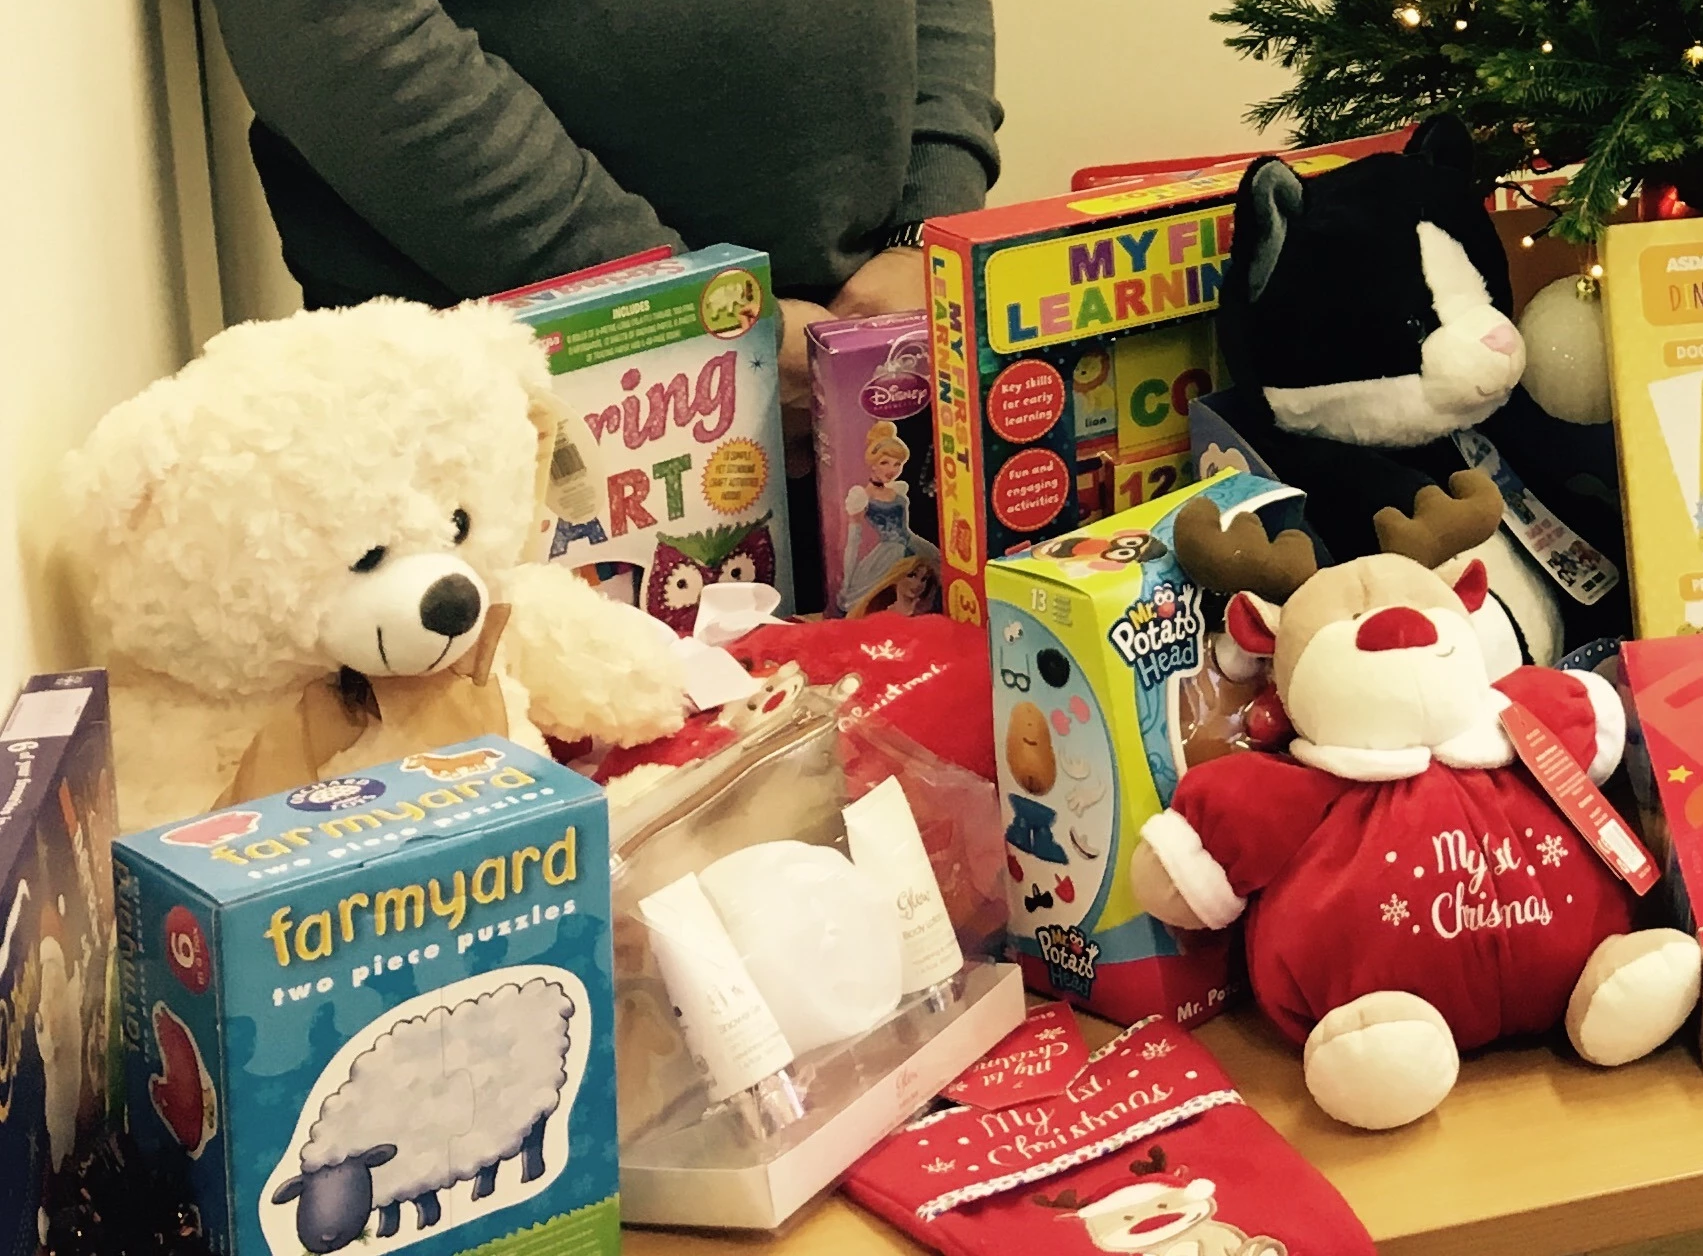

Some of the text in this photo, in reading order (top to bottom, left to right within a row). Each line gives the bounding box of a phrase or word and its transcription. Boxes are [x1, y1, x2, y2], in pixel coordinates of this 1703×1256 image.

[1068, 228, 1159, 285] MY
[612, 299, 651, 320] INCLUDES
[1006, 258, 1232, 344] LEARNIN
[866, 383, 928, 407] Disney
[932, 256, 958, 503] LEARNING BOX
[948, 300, 970, 472] MY FIRST
[1001, 375, 1053, 395] Key skills
[1002, 393, 1054, 410] for early
[1004, 409, 1053, 427] learning
[1085, 416, 1107, 427] lion
[1006, 479, 1059, 499] engaging
[1009, 462, 1054, 481] Fun and
[1006, 494, 1059, 514] activities
[1031, 588, 1047, 612] 13
[1128, 601, 1157, 631] Mr.
[1111, 611, 1197, 662] Potato
[1137, 638, 1195, 686] Head
[211, 766, 536, 865] farmyard
[248, 787, 554, 879] two piece puzzles
[1431, 829, 1488, 894] My
[263, 826, 577, 967] farmyard
[113, 859, 141, 1052] farmyard
[171, 931, 196, 969] 6
[272, 898, 577, 1007] two piece puzzles
[1038, 930, 1095, 979] Potato
[1051, 964, 1091, 996] Head
[1177, 1001, 1203, 1023] Mr.
[982, 1060, 1052, 1086] My 1st
[976, 1074, 1110, 1137] My 1st
[987, 1083, 1174, 1167] Christmas
